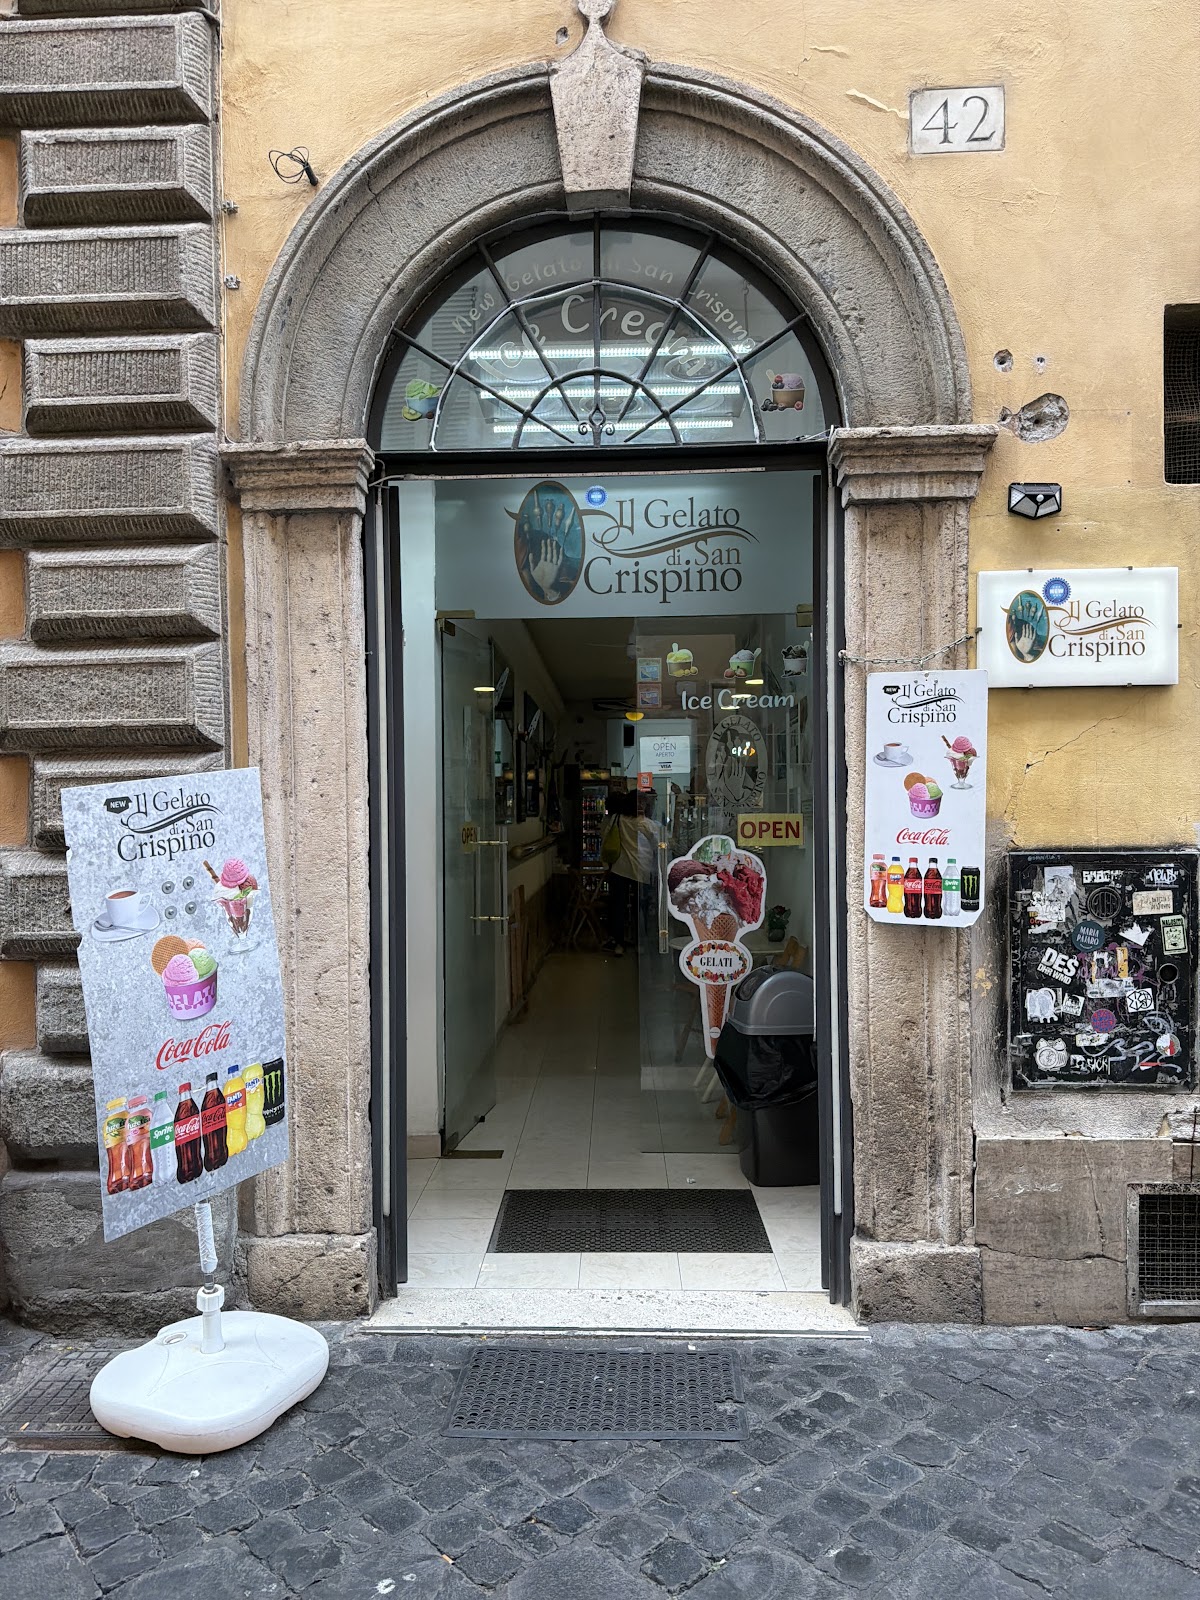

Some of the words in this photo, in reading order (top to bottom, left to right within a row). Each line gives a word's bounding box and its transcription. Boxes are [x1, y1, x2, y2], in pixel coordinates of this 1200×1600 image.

[915, 90, 975, 130] 42
[506, 256, 583, 292] Gelato
[630, 256, 674, 285] San
[688, 279, 756, 352] rispino
[476, 323, 548, 382] Ice
[561, 294, 709, 378] Cream
[615, 497, 635, 536] Il
[644, 496, 741, 529] Gelato
[666, 547, 683, 567] di
[693, 538, 742, 567] San
[583, 555, 743, 604] Crispino
[1068, 600, 1080, 621] Il
[1085, 599, 1145, 619] Gelato
[1099, 628, 1109, 640] di
[1116, 623, 1145, 641] San
[1048, 634, 1146, 663] Crispino
[681, 690, 712, 710] Ice
[717, 688, 795, 709] Cream
[902, 684, 911, 699] Il
[914, 683, 956, 697] Gelato
[887, 707, 957, 727] Crispino
[922, 703, 930, 712] di
[935, 701, 956, 712] San
[721, 715, 762, 742] GELATO
[653, 742, 677, 751] OPEN
[109, 800, 127, 809] NEW
[134, 792, 148, 818] Il
[152, 788, 211, 813] Gelato
[169, 823, 179, 835] di
[185, 815, 214, 834] San
[461, 826, 477, 845] OPEN
[740, 820, 801, 839] OPEN
[117, 830, 216, 862] Crispino
[896, 827, 950, 846] Coca-Cola
[1079, 925, 1100, 938] MARIA
[700, 956, 733, 968] GELATI
[1041, 947, 1080, 978] DES
[1052, 970, 1072, 985] WMD
[156, 1020, 233, 1071] Coca-Cola
[153, 1124, 174, 1140] Sprite
